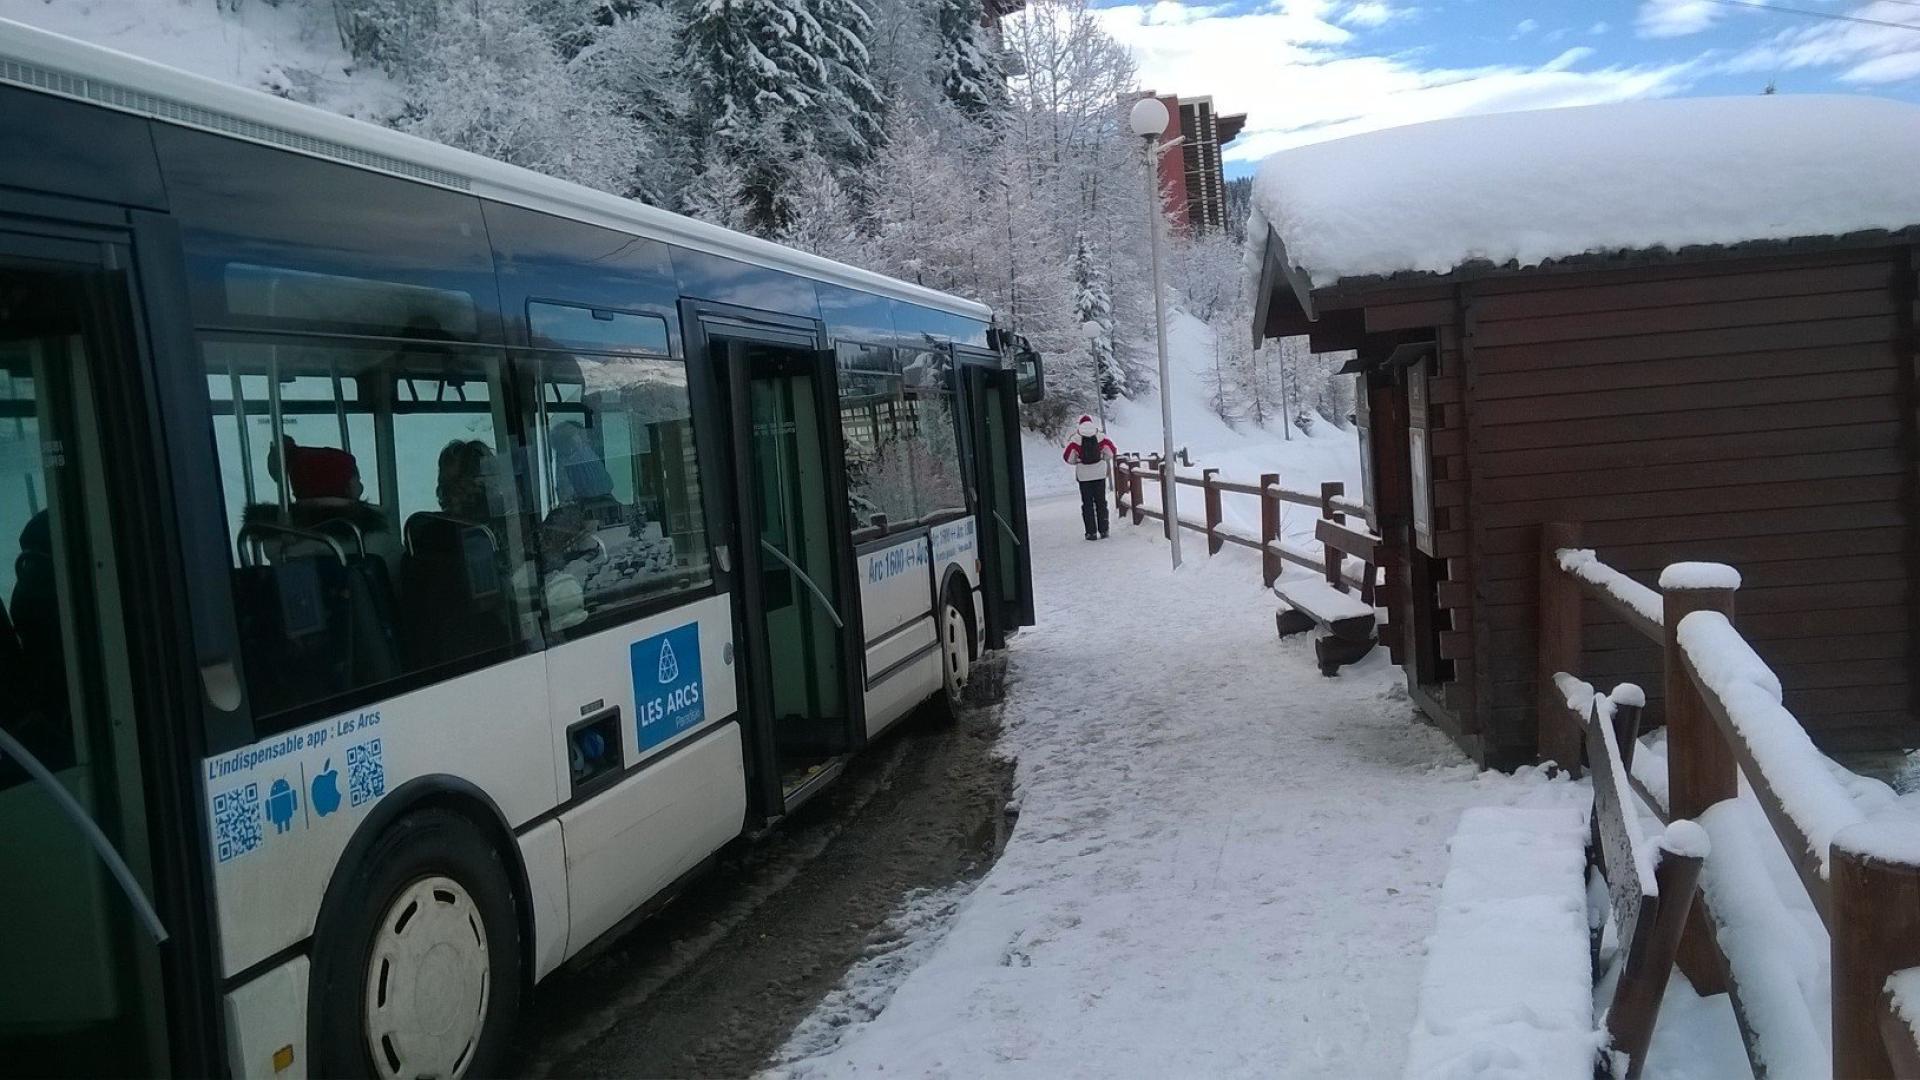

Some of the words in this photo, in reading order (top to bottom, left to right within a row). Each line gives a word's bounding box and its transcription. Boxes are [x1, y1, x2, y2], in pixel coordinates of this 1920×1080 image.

[868, 557, 883, 584] Arc
[886, 548, 904, 577] 1600
[640, 698, 663, 727] LES
[667, 682, 699, 715] ARCS
[209, 735, 304, 780] L'indispensable
[307, 729, 328, 748] app
[337, 720, 355, 737] Les
[358, 711, 381, 728] Arcs
